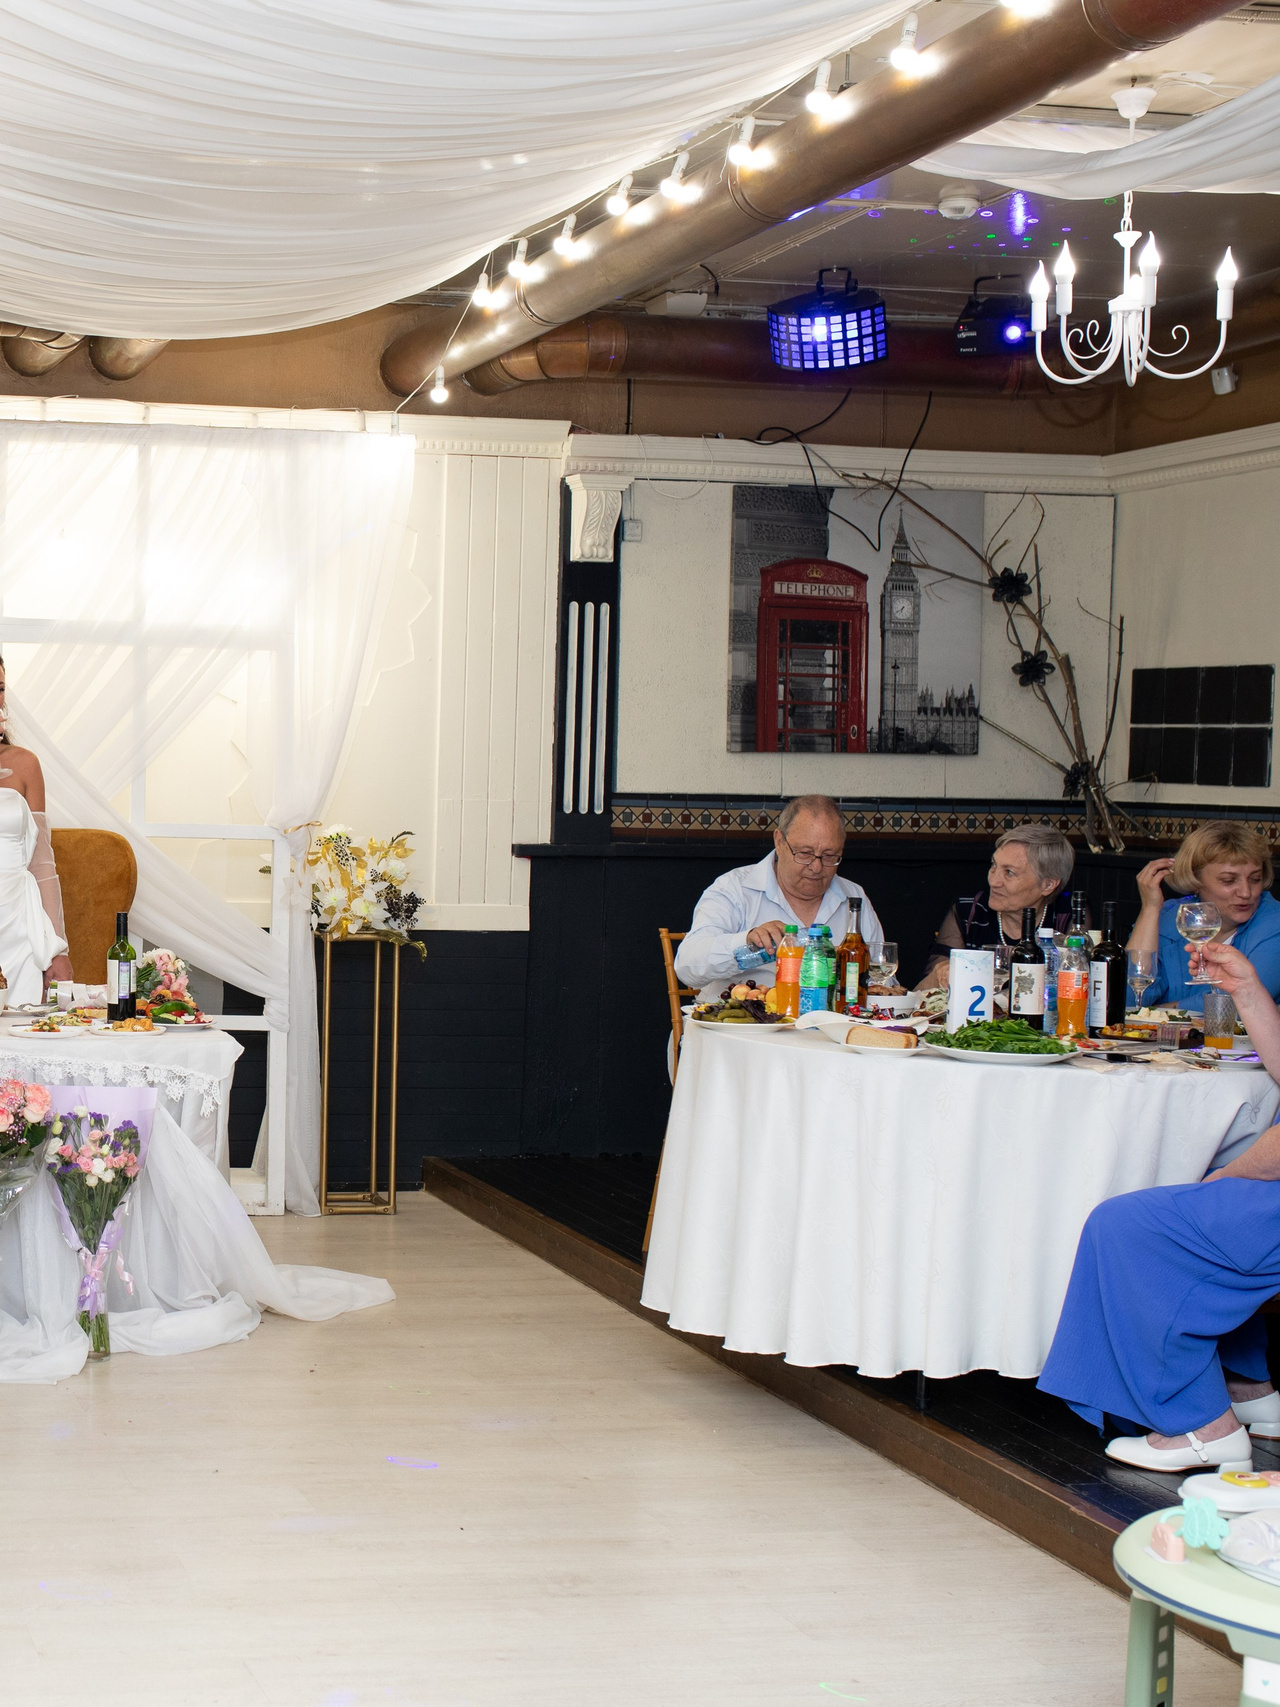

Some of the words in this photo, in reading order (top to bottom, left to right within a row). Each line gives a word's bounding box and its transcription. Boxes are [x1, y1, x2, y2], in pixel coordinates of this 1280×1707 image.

[777, 582, 852, 597] TELEPHONE
[1093, 980, 1103, 997] F
[968, 985, 986, 1016] 2
